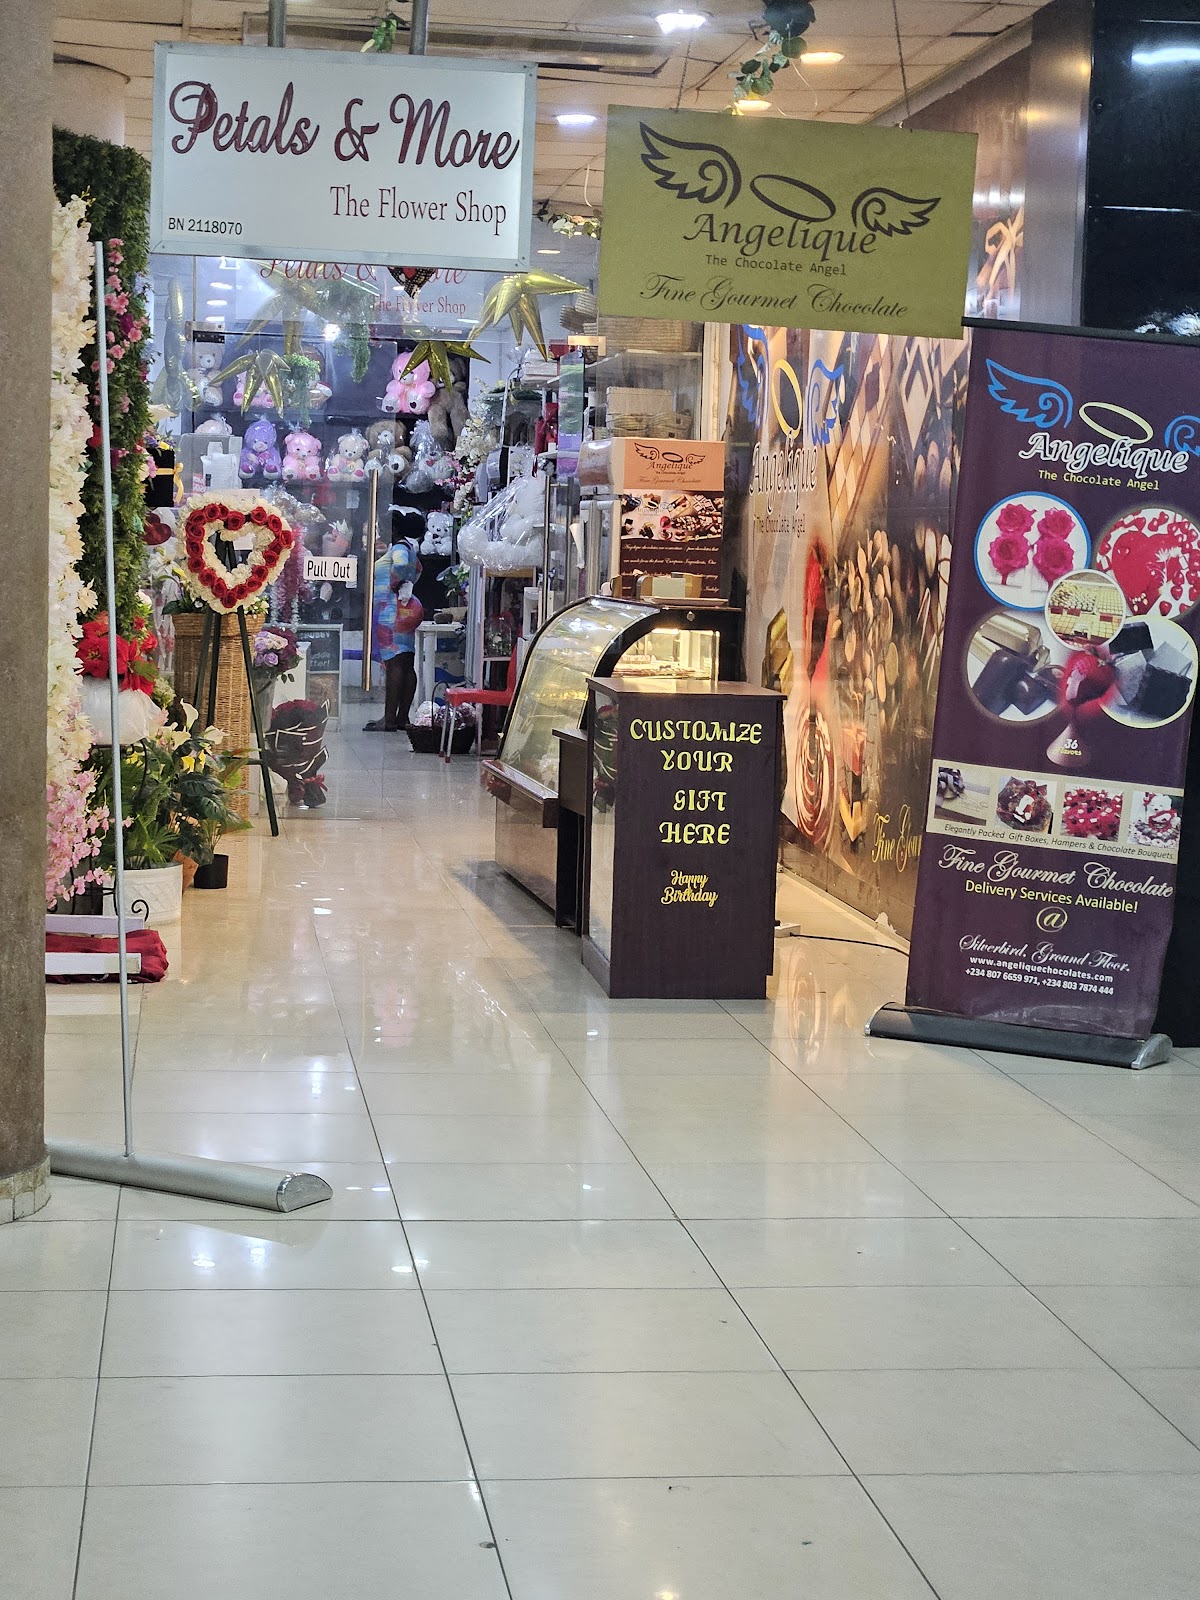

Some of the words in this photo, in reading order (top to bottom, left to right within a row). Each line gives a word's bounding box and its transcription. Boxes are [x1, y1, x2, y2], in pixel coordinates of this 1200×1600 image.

[169, 81, 320, 155] Petals
[334, 98, 380, 162] &
[389, 93, 520, 170] More
[330, 184, 370, 218] The
[379, 186, 448, 222] Flower
[455, 191, 507, 236] Shop
[168, 217, 184, 231] BN
[188, 218, 243, 235] 2118070
[683, 212, 877, 262] Angelique
[705, 254, 728, 268] The
[735, 256, 803, 273] Chocolate
[809, 263, 847, 277] Angel
[372, 294, 391, 311] The
[438, 296, 466, 317] Shop
[640, 271, 696, 301] Fine
[700, 275, 798, 312] Gourmet
[806, 283, 909, 318] Chocolate
[647, 461, 693, 472] Angelique
[1018, 431, 1189, 479] Angelique
[749, 441, 818, 515] Angelique
[1038, 469, 1057, 481] The
[1063, 472, 1121, 487] Chocolate
[1127, 480, 1160, 491] Angel
[307, 560, 327, 577] Pull
[333, 561, 351, 579] Out
[629, 718, 763, 744] CUSTOMIZE
[1063, 738, 1078, 749] 36
[660, 749, 733, 772] YOUR
[673, 789, 727, 811] GIFT
[658, 821, 731, 845] HERE
[872, 812, 895, 863] Fine
[944, 824, 976, 839] Elegantly
[977, 829, 1005, 839] Packed
[1008, 832, 1023, 842] Gift
[1025, 834, 1049, 845] Boxes,
[1051, 838, 1086, 851] Hampers
[1097, 843, 1136, 854] Chocolate
[670, 869, 709, 889] Happy
[938, 844, 985, 874] Fine
[987, 850, 1076, 886] Gourmet
[1083, 861, 1174, 898] Chocolate
[660, 885, 719, 907] Birthday
[965, 879, 1018, 900] Delivery
[1019, 887, 1073, 906] Services
[1074, 893, 1139, 914] Available!
[1036, 906, 1068, 933] @
[959, 933, 1027, 958] Silverbird.
[1031, 941, 1087, 966] Ground
[1088, 949, 1131, 972] Floor.
[965, 967, 985, 978] +234
[986, 970, 1001, 980] 807
[1002, 972, 1022, 983] 6659
[1023, 975, 1041, 986] 971,
[1042, 977, 1062, 989] +234
[1062, 980, 1078, 991] 803
[1078, 983, 1098, 994] 7874
[1098, 985, 1114, 996] 444
[969, 955, 1113, 983] www.angeliquechocolates.com
